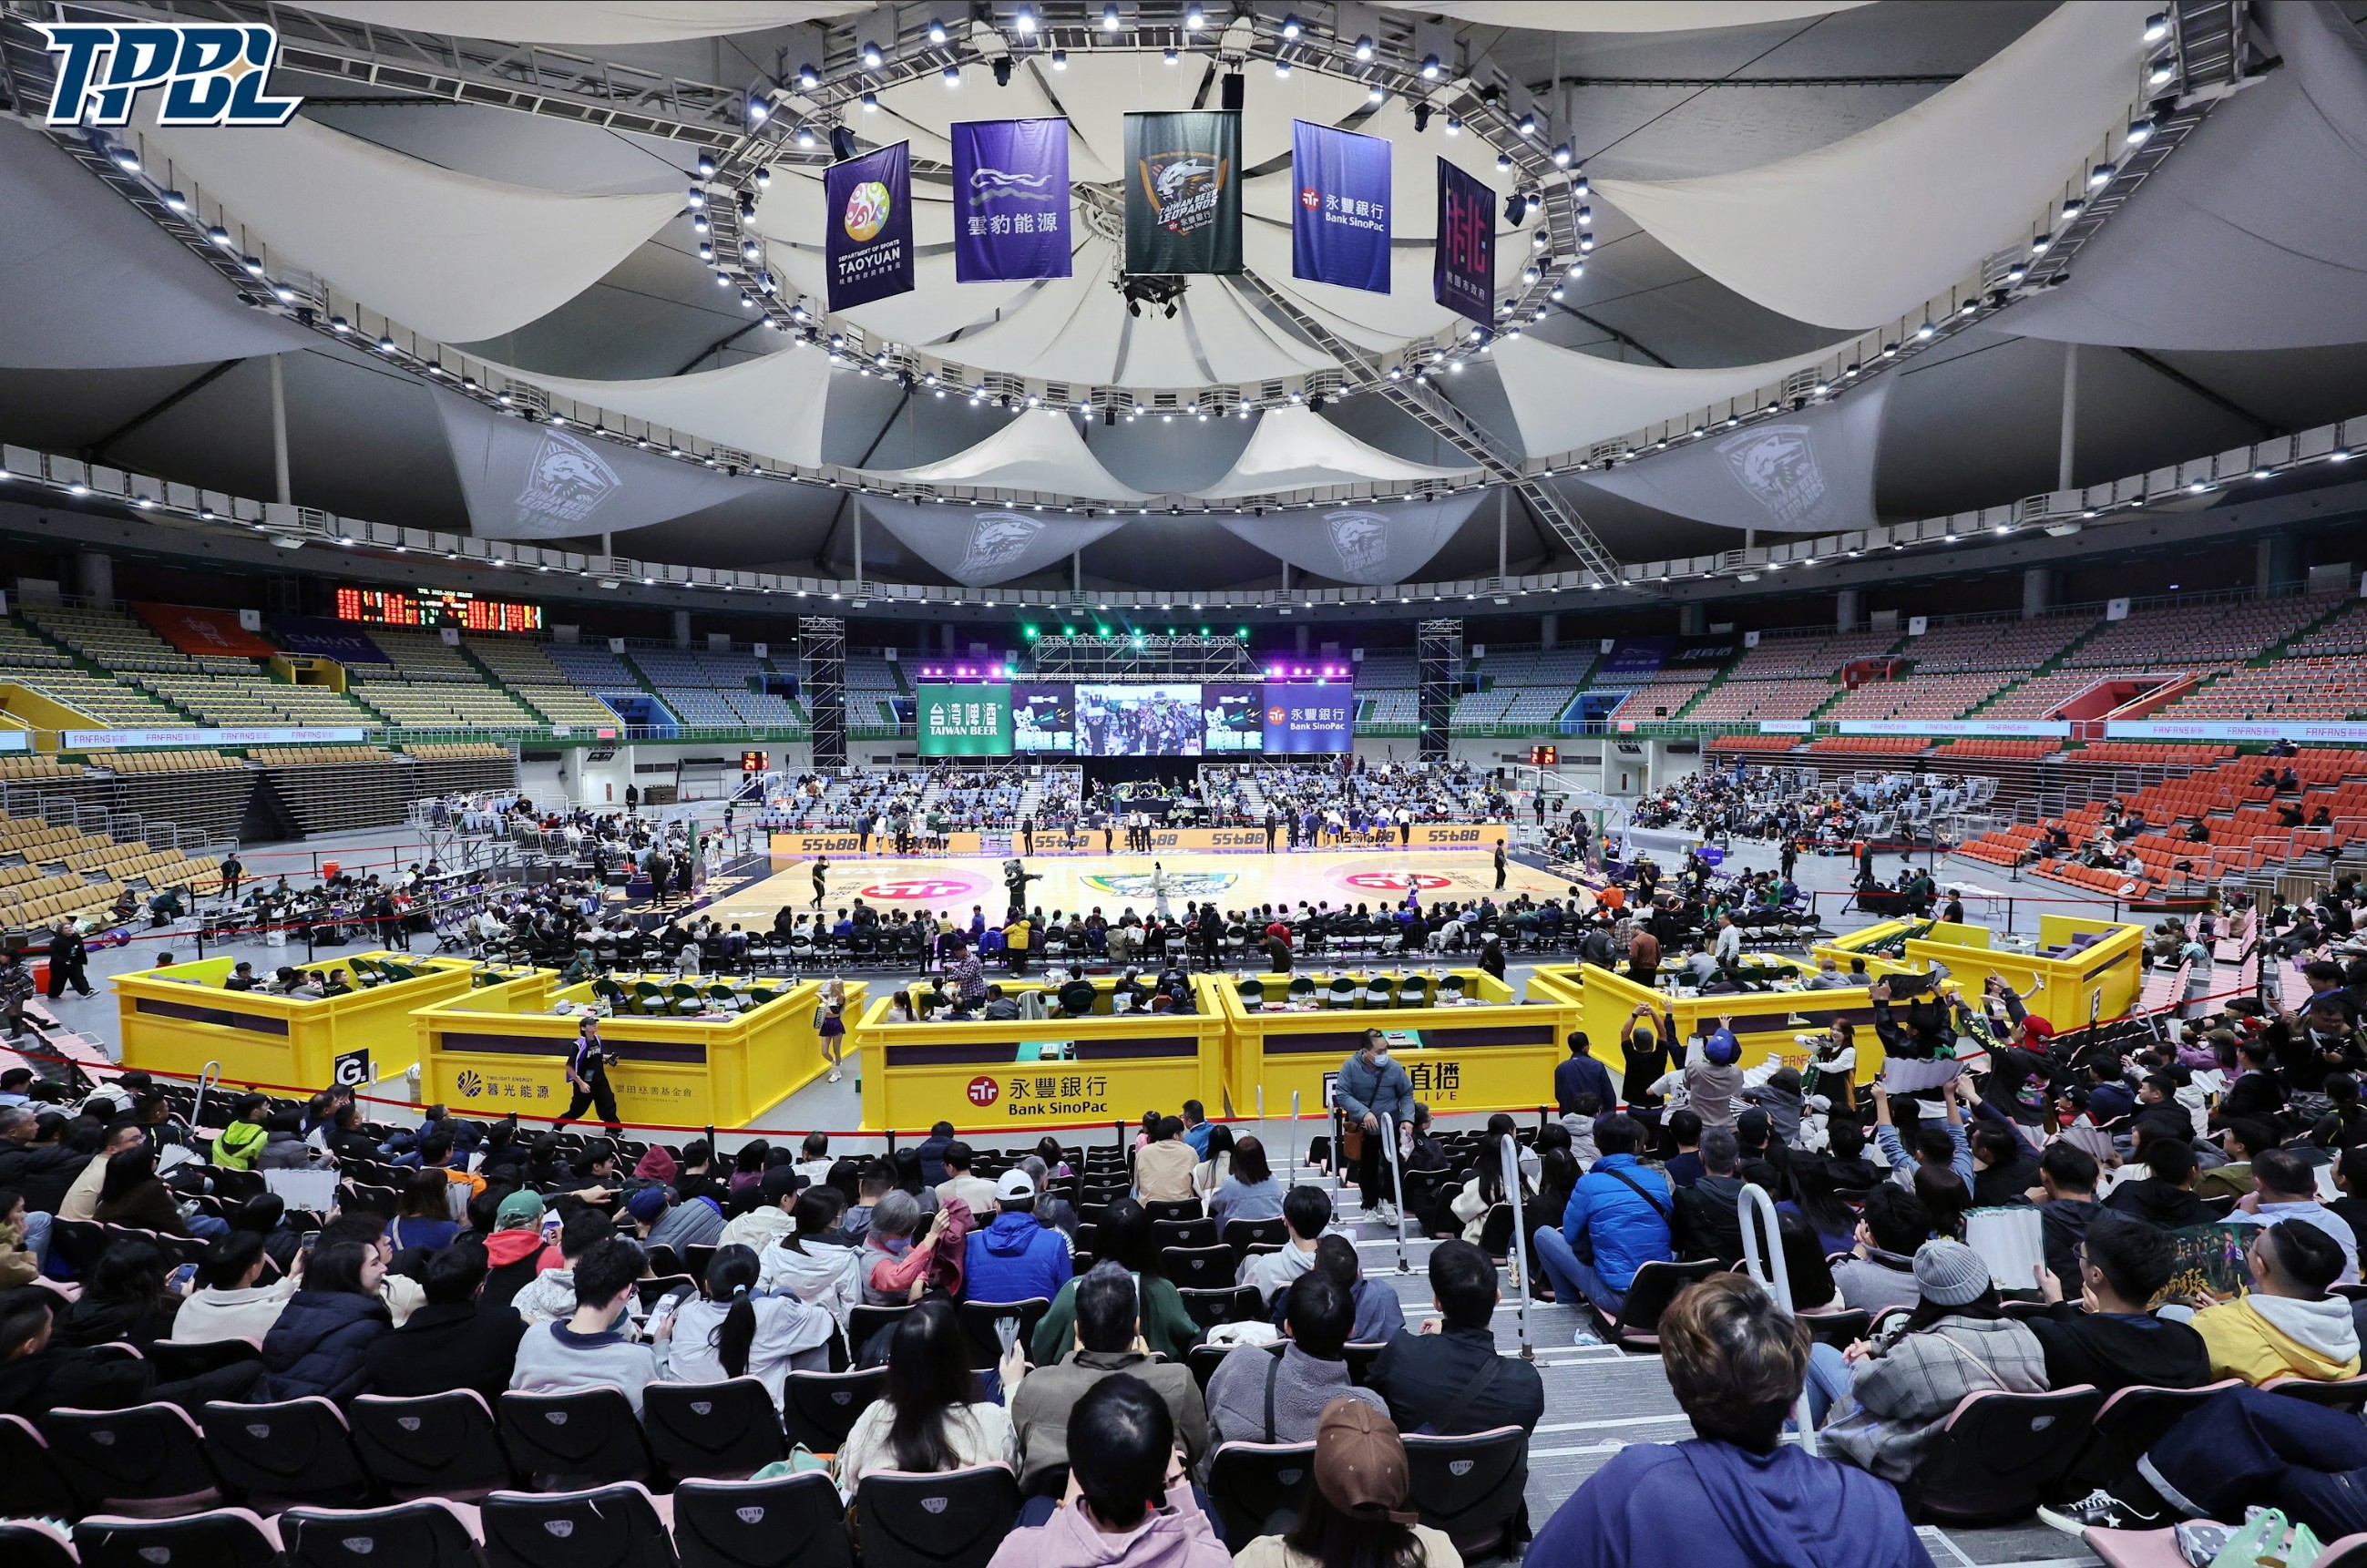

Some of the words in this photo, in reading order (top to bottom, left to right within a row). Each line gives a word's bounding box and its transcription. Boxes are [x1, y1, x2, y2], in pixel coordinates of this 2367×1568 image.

[1160, 198, 1194, 215] TAIWAN
[1194, 189, 1218, 202] BEER
[1326, 194, 1384, 220] 永豐銀行
[1157, 196, 1218, 225] LEOPARDS
[968, 212, 1058, 236] 雲豹能源
[1326, 211, 1347, 224] Bank
[1349, 217, 1384, 231] SinoPac
[838, 248, 871, 262] DEPARTMENT
[880, 239, 900, 250] SPORTS
[838, 247, 900, 275] TAOYUAN
[1290, 708, 1345, 721] 永豐銀行
[221, 732, 254, 740] FANFANS
[292, 731, 321, 739] FANFANS
[929, 726, 967, 735] TAIWAN
[970, 726, 998, 735] BEER
[2227, 726, 2261, 735] FANFANS
[2306, 728, 2346, 736] FANFANS
[74, 734, 110, 743] FANFANS
[146, 733, 182, 742] FANFANS
[745, 760, 755, 769] 24
[1212, 833, 1265, 845] 55688
[1429, 830, 1481, 842] 55688
[802, 837, 859, 851] 55688
[1403, 1062, 1460, 1090] 直播
[487, 1083, 548, 1099] 暮光能源
[1009, 1076, 1107, 1099] 永豐銀行
[1414, 1091, 1457, 1101] IVE
[1009, 1103, 1045, 1115] Bank
[1050, 1102, 1107, 1113] SinoPac
